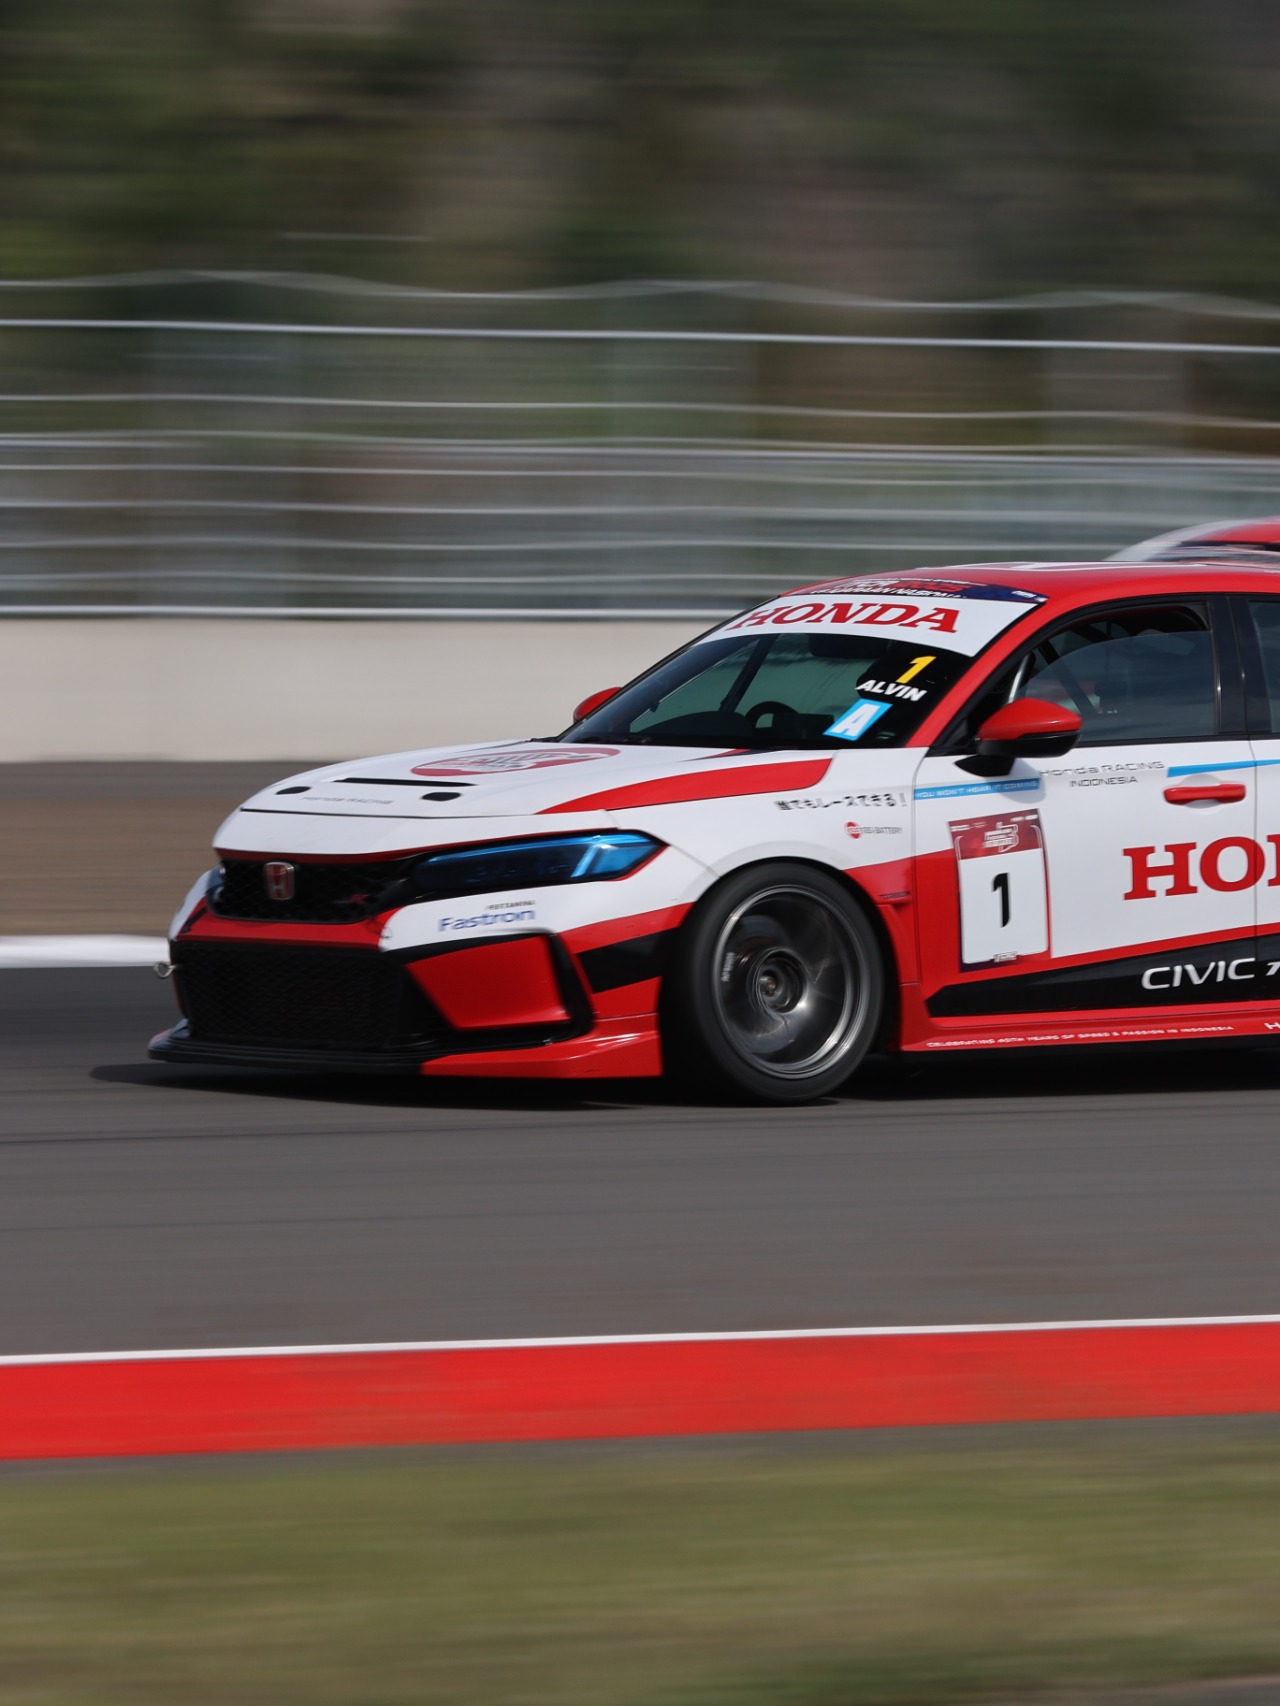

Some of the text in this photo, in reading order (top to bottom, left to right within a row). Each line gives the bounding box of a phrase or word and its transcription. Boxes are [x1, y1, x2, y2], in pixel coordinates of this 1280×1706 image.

[725, 602, 960, 634] HONDA
[895, 655, 937, 684] 1
[854, 679, 928, 702] ALVIN
[829, 703, 881, 737] A
[1069, 775, 1139, 788] INDONESIA
[1101, 761, 1166, 774] RACING
[991, 872, 1010, 928] 1
[437, 908, 536, 933] Fastron
[1142, 957, 1256, 990] CIVIC
